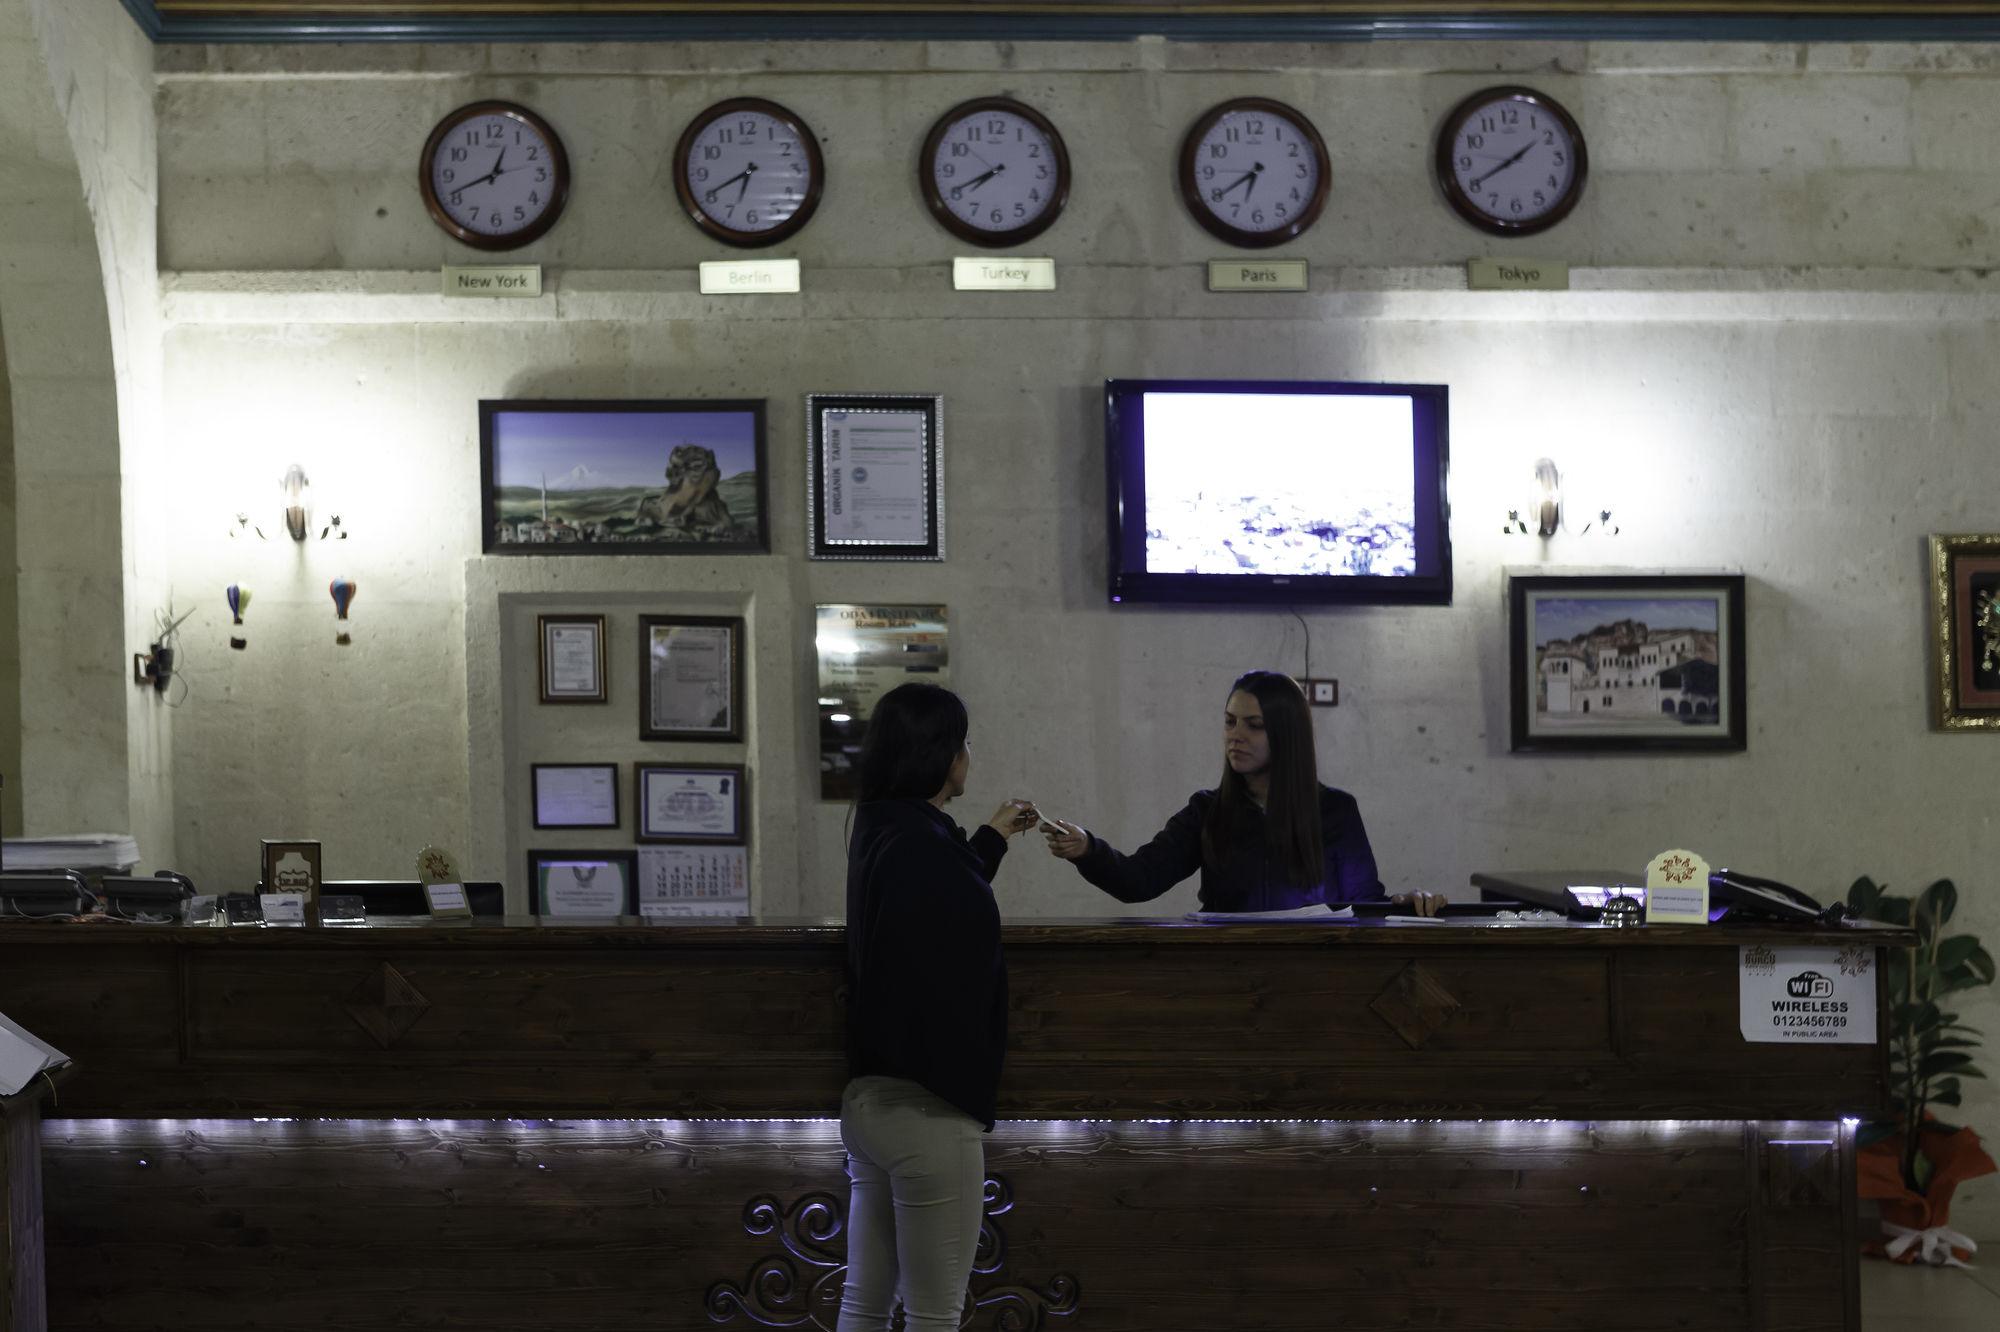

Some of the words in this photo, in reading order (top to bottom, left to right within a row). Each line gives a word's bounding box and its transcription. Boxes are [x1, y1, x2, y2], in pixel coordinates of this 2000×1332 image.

[1501, 110, 1519, 124] 12
[1530, 115, 1536, 130] 1
[486, 124, 504, 139] 12
[738, 121, 756, 136] 12
[988, 120, 1005, 135] 12
[1246, 120, 1264, 135] 12
[1482, 118, 1495, 132] 11
[466, 131, 480, 146] 11
[515, 131, 521, 145] 1
[719, 129, 732, 143] 11
[768, 127, 774, 141] 1
[967, 127, 981, 141] 11
[1016, 128, 1023, 142] 1
[1226, 128, 1239, 142] 11
[1275, 127, 1281, 142] 1
[1543, 131, 1554, 145] 2
[780, 142, 791, 156] 2
[1467, 135, 1484, 149] 10
[451, 148, 467, 162] 10
[526, 147, 538, 161] 2
[704, 145, 721, 160] 10
[951, 142, 968, 157] 10
[1028, 143, 1039, 158] 2
[1210, 144, 1227, 159] 10
[1287, 143, 1298, 158] 2
[1460, 157, 1472, 171] 9
[1553, 152, 1564, 166] 3
[442, 169, 455, 183] 9
[535, 168, 546, 182] 3
[697, 167, 708, 182] 9
[943, 163, 955, 178] 9
[1035, 165, 1048, 180] 3
[1202, 166, 1215, 180] 9
[1296, 164, 1307, 179] 3
[1469, 179, 1482, 193] 8
[1547, 175, 1558, 189] 4
[451, 192, 462, 206] 8
[528, 191, 539, 205] 4
[705, 190, 718, 204] 8
[951, 187, 963, 201] 8
[1028, 187, 1039, 202] 4
[1211, 187, 1223, 202] 8
[1289, 187, 1298, 202] 4
[1489, 192, 1498, 208] 7
[1533, 191, 1545, 205] 5
[725, 205, 735, 219] 7
[969, 202, 980, 217] 7
[1014, 203, 1025, 218] 5
[1230, 203, 1240, 218] 7
[1275, 203, 1287, 218] 5
[1510, 198, 1522, 213] 6
[469, 207, 480, 221] 7
[490, 213, 502, 227] 6
[513, 206, 525, 220] 5
[746, 210, 758, 224] 6
[990, 209, 1003, 223] 6
[1251, 210, 1264, 224] 6
[458, 275, 491, 288] New
[495, 274, 528, 288] York
[728, 272, 772, 284] Berlin
[981, 267, 1030, 282] Turkey
[1240, 269, 1277, 282] Paris
[1496, 267, 1540, 282] Tokyo
[1771, 1000, 1849, 1013] WIRELESS
[1773, 1015, 1847, 1027] 0123456789
